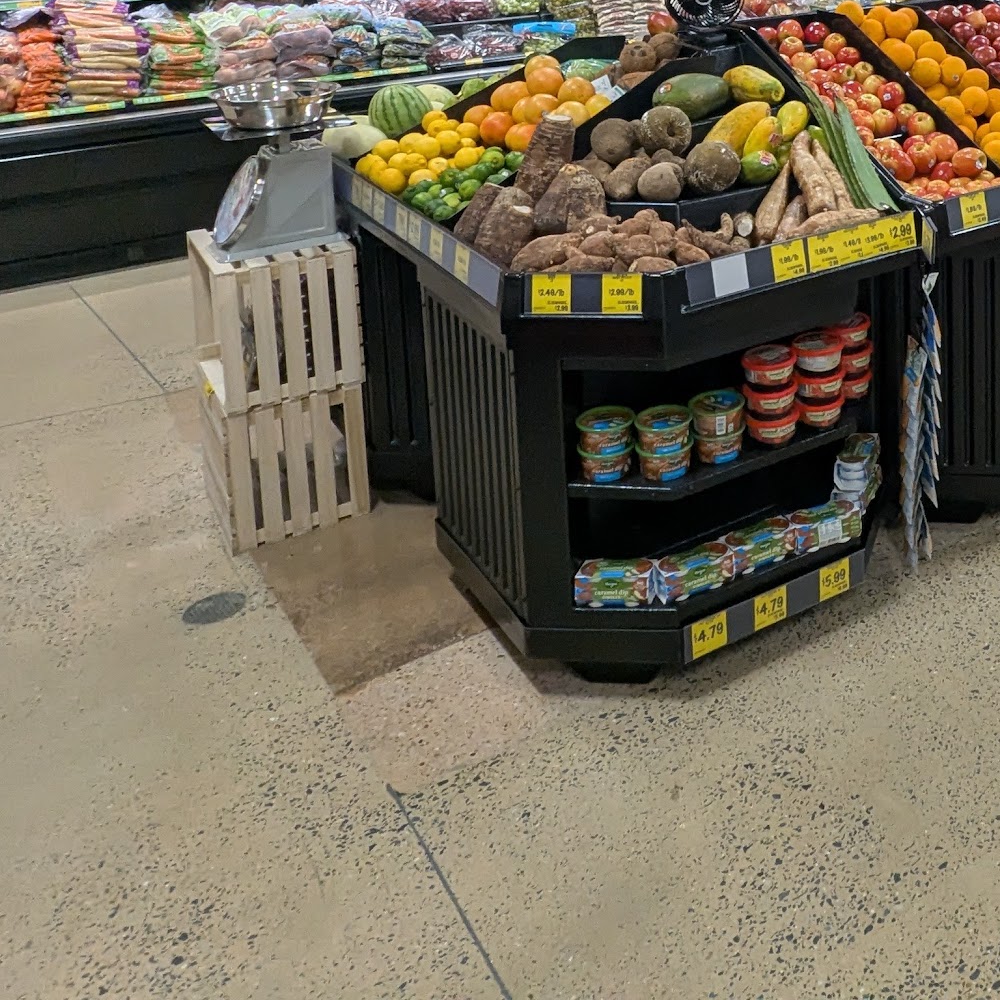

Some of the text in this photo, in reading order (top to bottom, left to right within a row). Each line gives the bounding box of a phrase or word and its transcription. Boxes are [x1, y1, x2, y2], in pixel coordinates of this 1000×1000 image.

[822, 568, 846, 588] $5.99
[618, 589, 629, 597] dip
[756, 596, 784, 617] $4.79
[694, 622, 724, 644] $4.79
